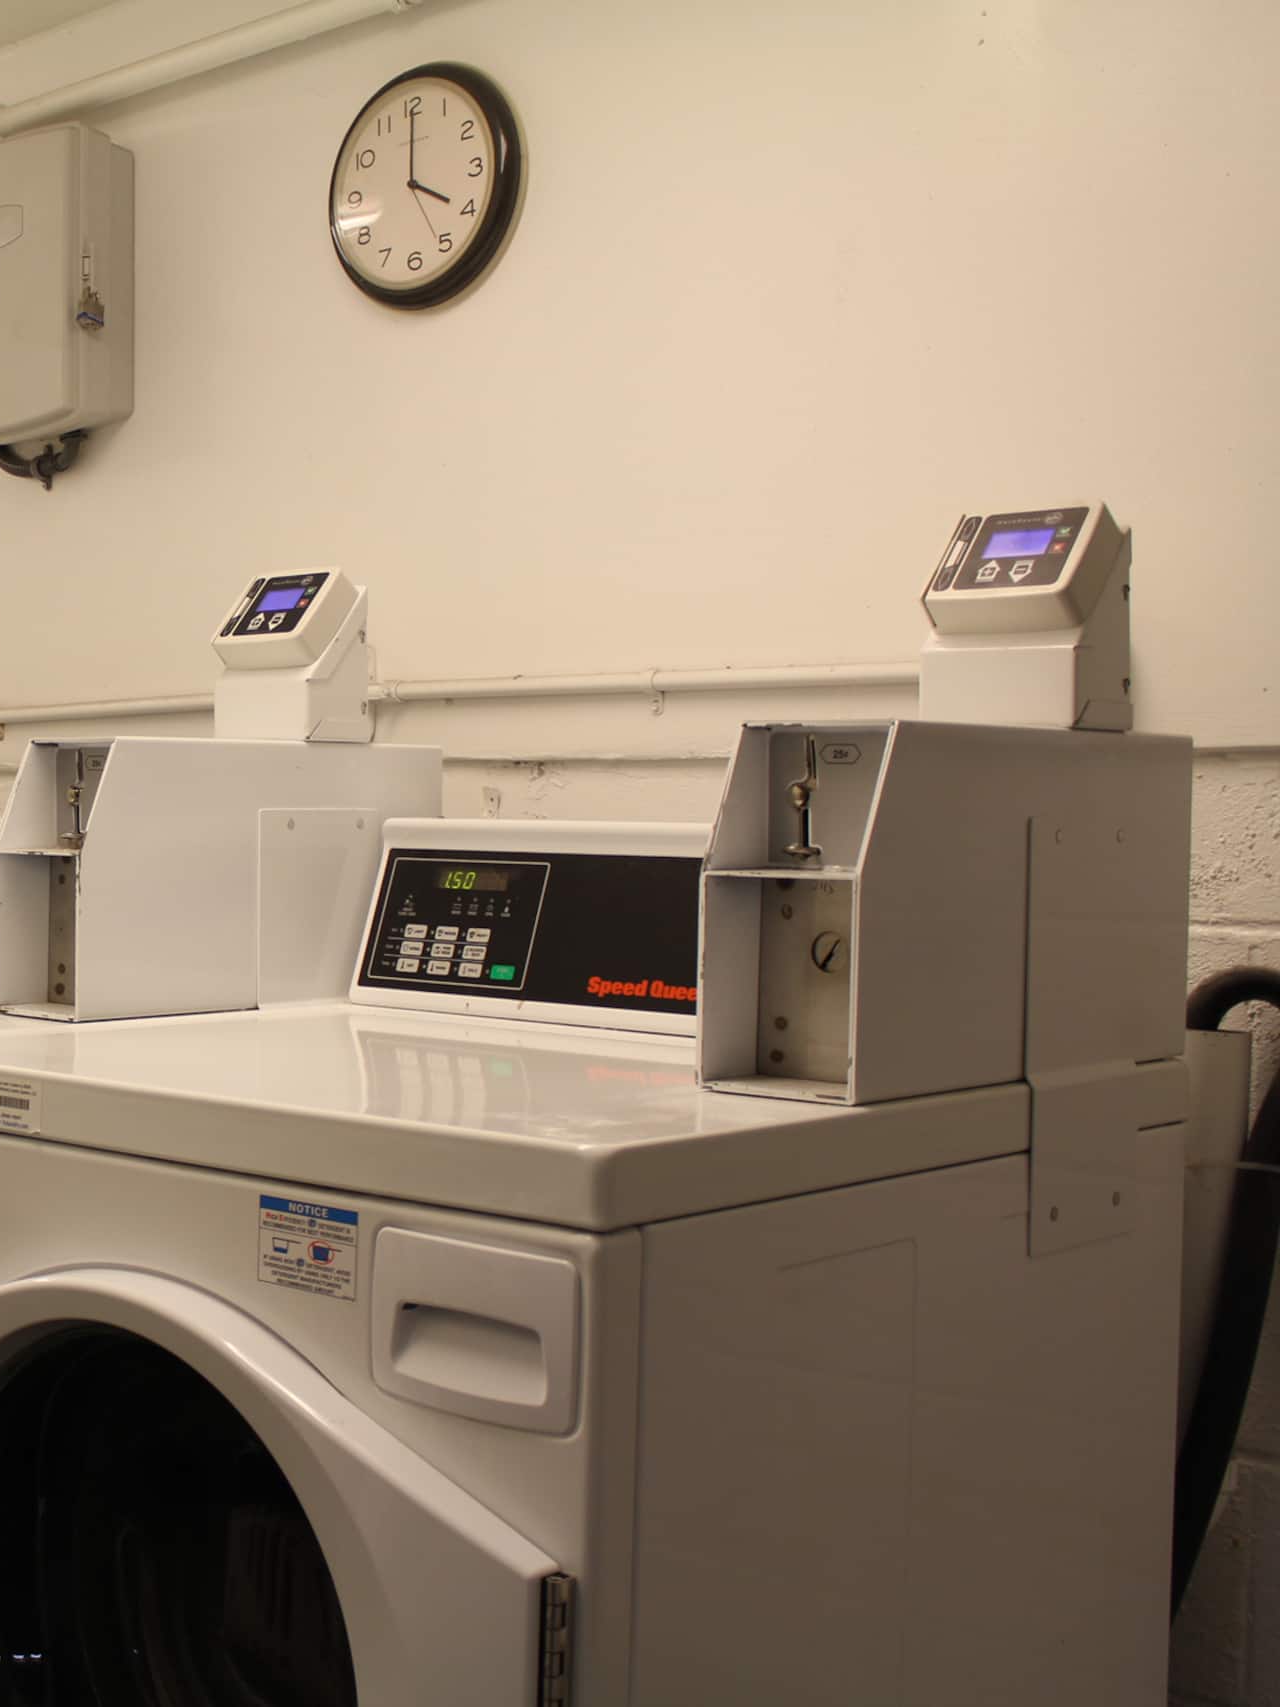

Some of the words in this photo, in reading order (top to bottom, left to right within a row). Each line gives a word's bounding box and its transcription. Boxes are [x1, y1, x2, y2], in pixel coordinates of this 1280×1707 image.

[404, 96, 423, 118] 12
[377, 115, 392, 136] 11
[460, 120, 474, 141] 2
[356, 149, 376, 171] 10
[467, 157, 483, 177] 3
[347, 190, 362, 209] 9
[459, 199, 476, 217] 4
[357, 226, 371, 245] 8
[438, 233, 453, 253] 5
[378, 248, 392, 268] 7
[407, 251, 423, 271] 6
[587, 976, 649, 998] Speed
[650, 979, 697, 1001] Quee
[288, 1201, 329, 1218] NOTICE
